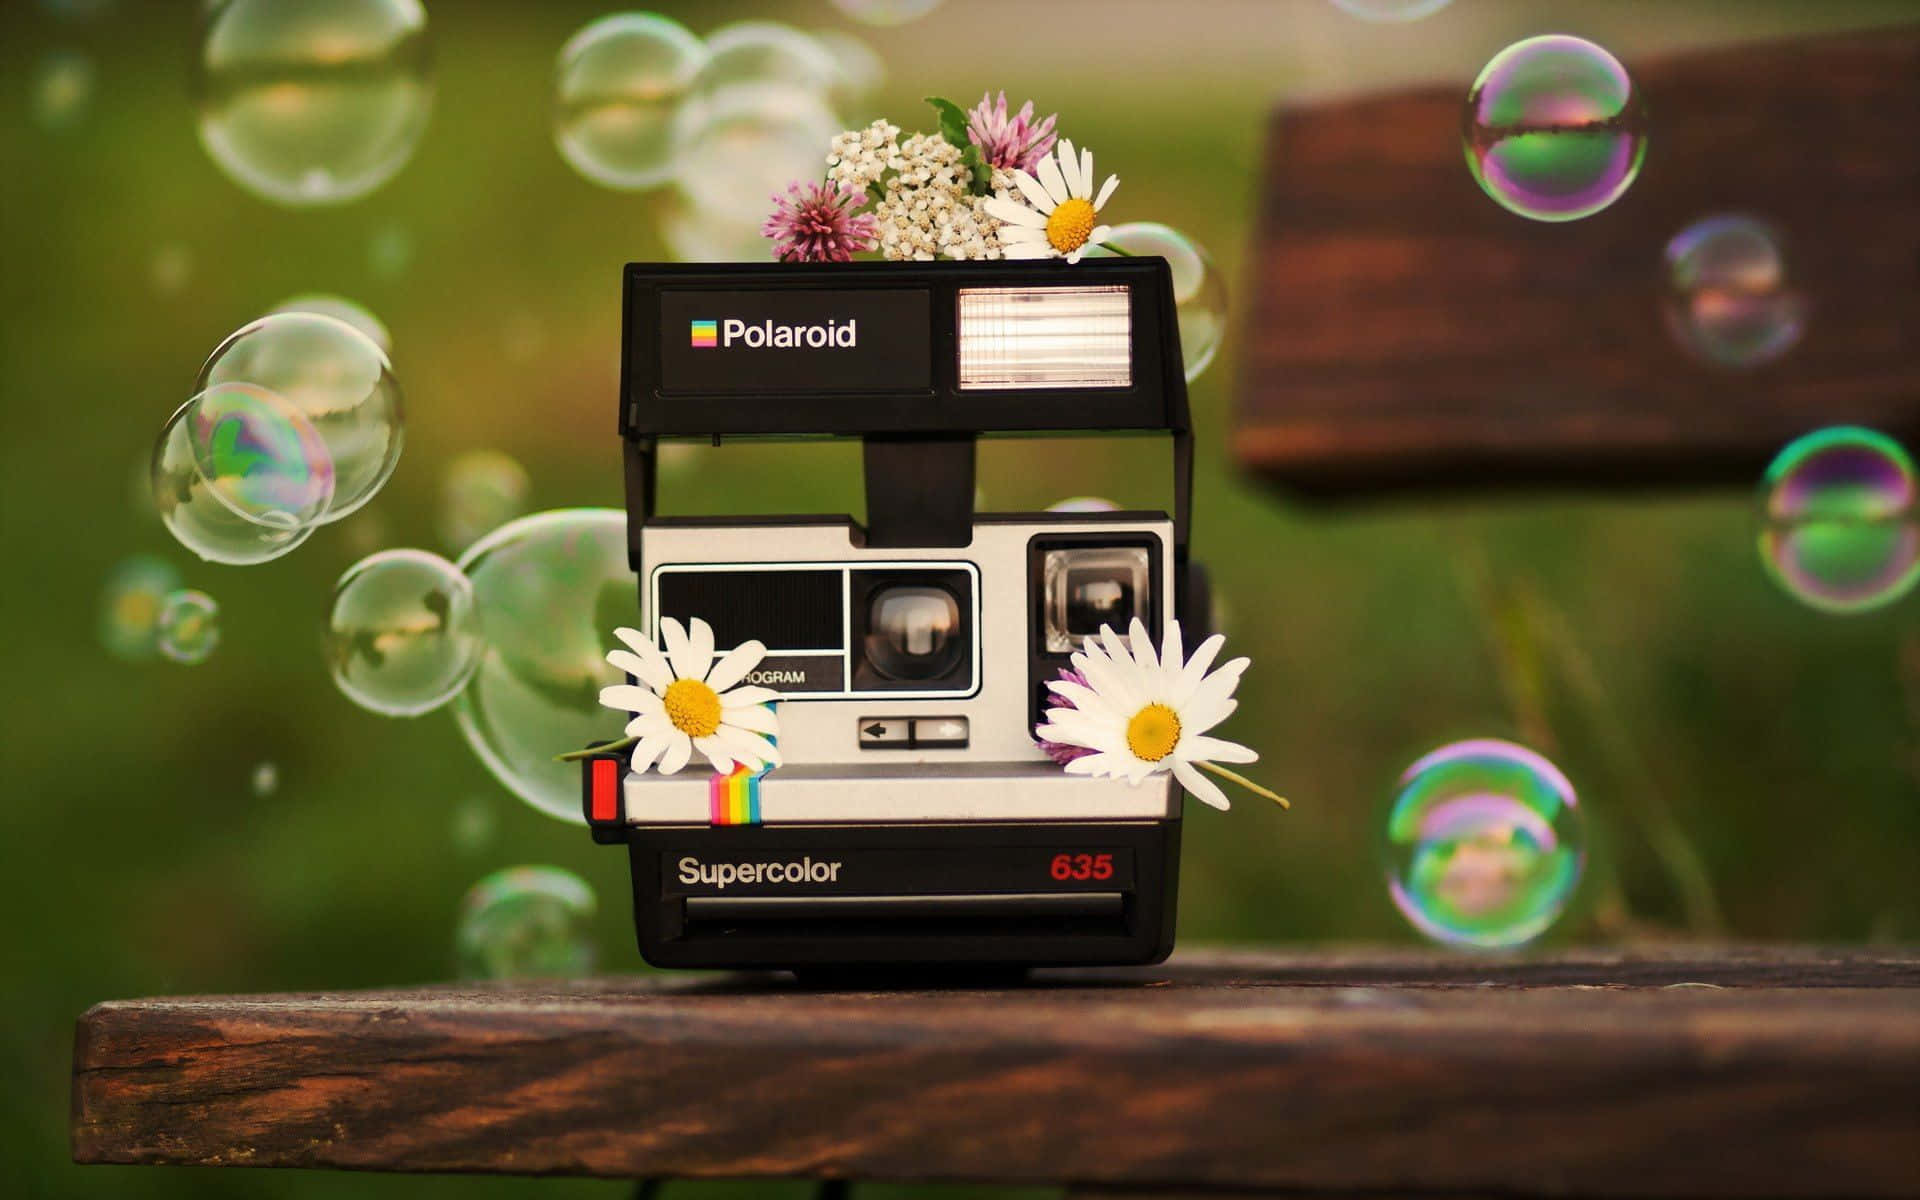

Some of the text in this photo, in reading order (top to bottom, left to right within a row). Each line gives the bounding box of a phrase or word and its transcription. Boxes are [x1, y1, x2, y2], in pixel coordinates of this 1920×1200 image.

[723, 319, 856, 348] Polaroid
[740, 670, 806, 684] ROGRAM
[678, 856, 842, 889] Supercolor
[1050, 853, 1114, 880] 635
